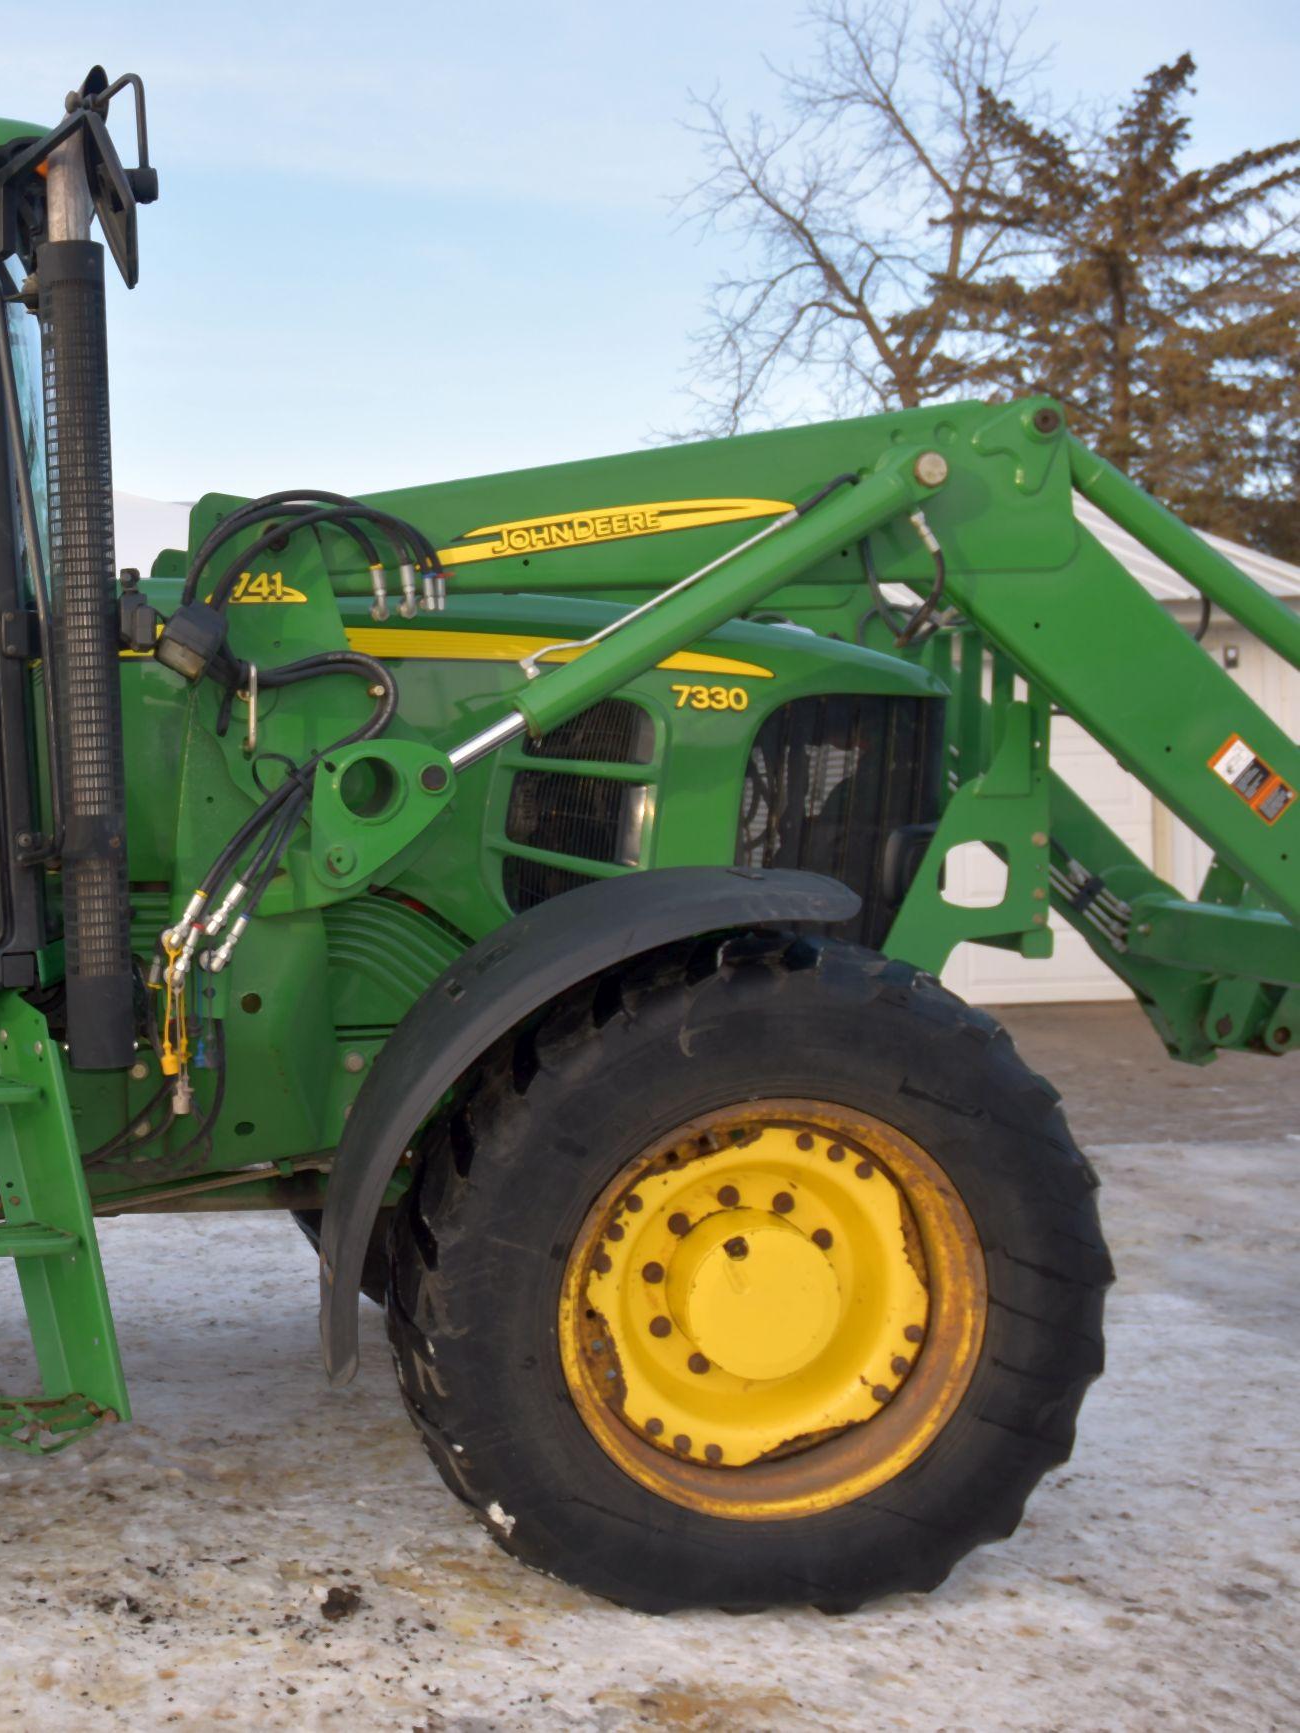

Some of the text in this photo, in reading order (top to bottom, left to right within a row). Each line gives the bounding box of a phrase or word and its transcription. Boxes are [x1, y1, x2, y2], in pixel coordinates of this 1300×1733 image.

[492, 510, 662, 554] JOHN DEERE
[671, 684, 748, 712] 7330
